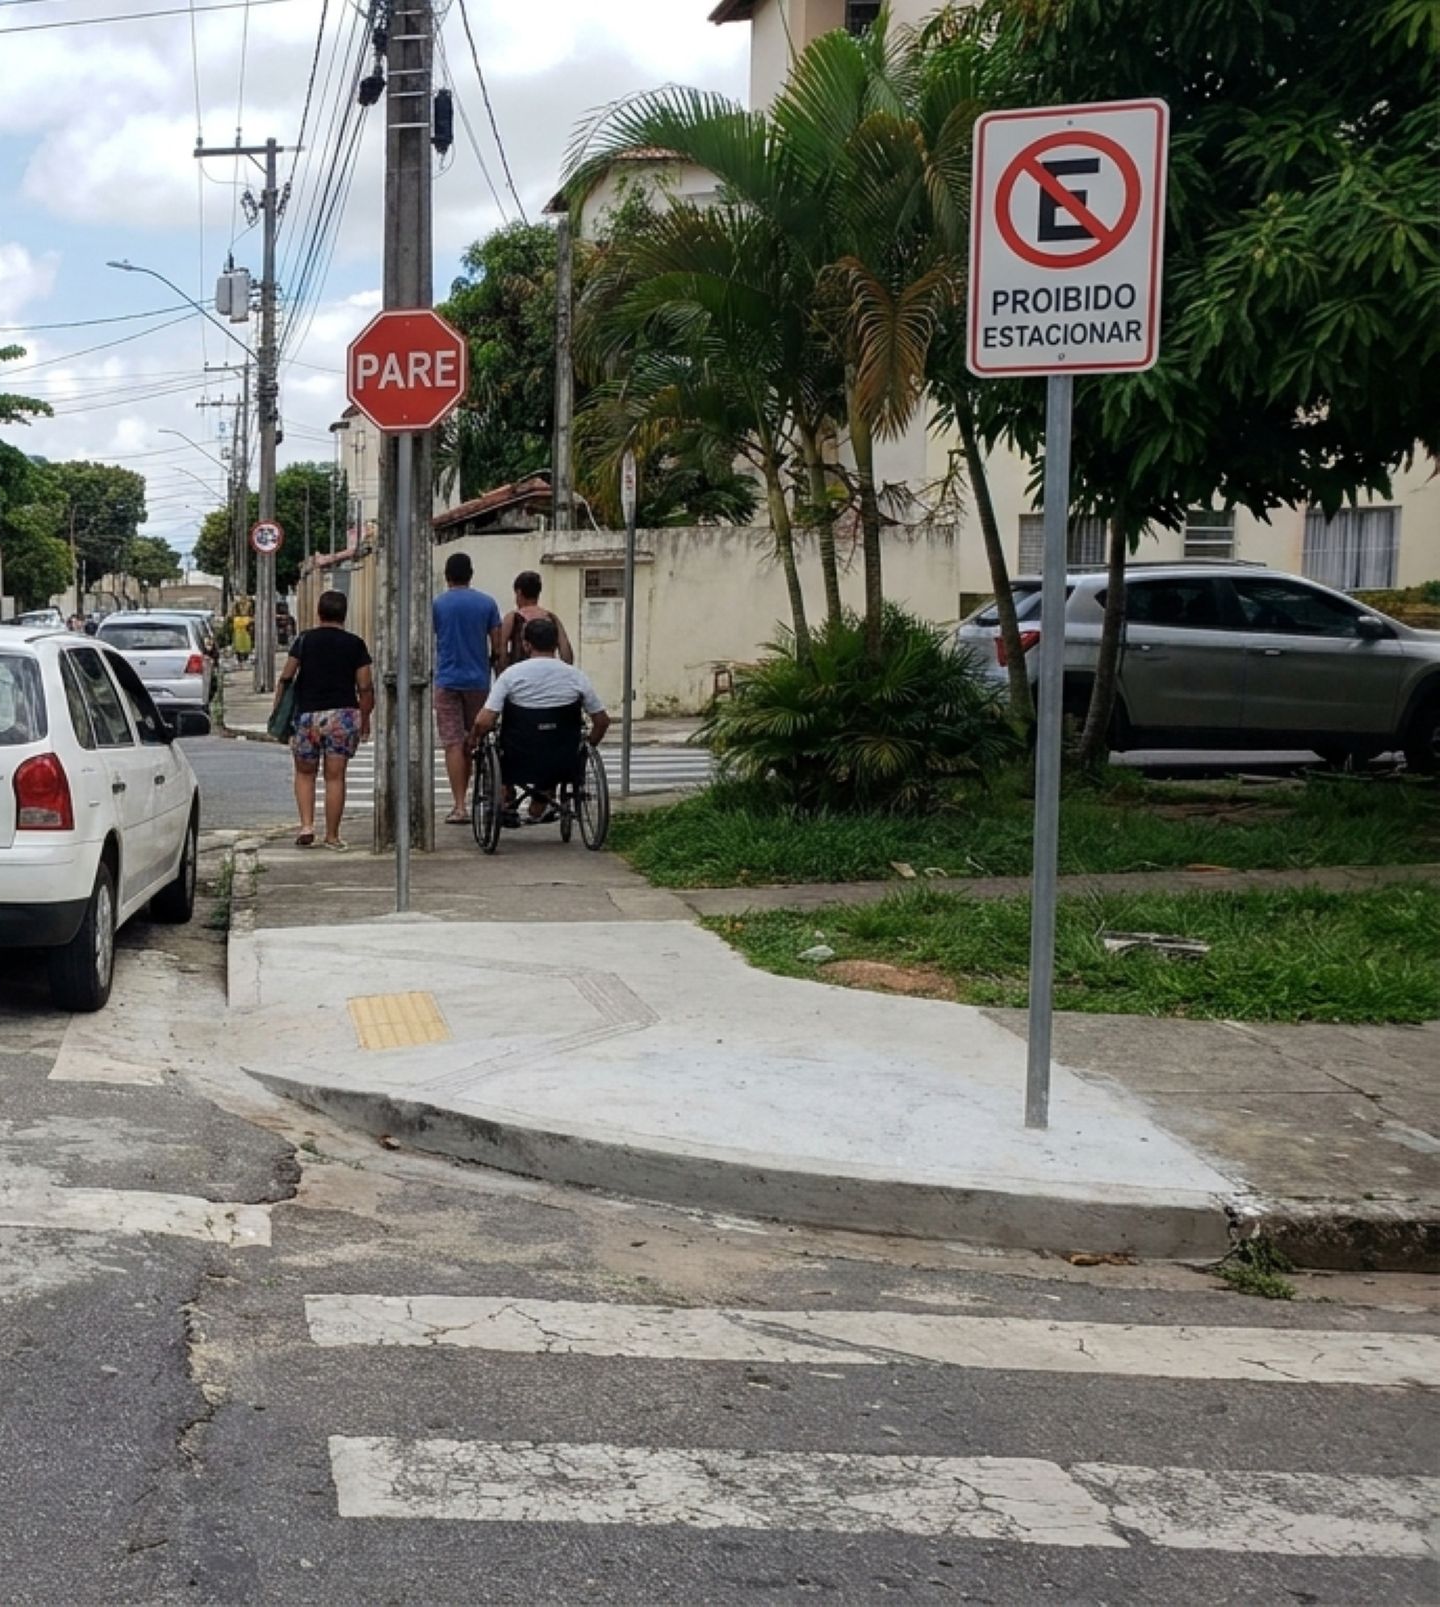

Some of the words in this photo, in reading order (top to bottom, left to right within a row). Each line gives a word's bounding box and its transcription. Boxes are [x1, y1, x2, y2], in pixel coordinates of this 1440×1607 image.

[1037, 157, 1101, 242] E
[992, 283, 1136, 316] PROIBIDO
[983, 320, 1143, 348] ESTACIONAR
[357, 350, 456, 390] PARE
